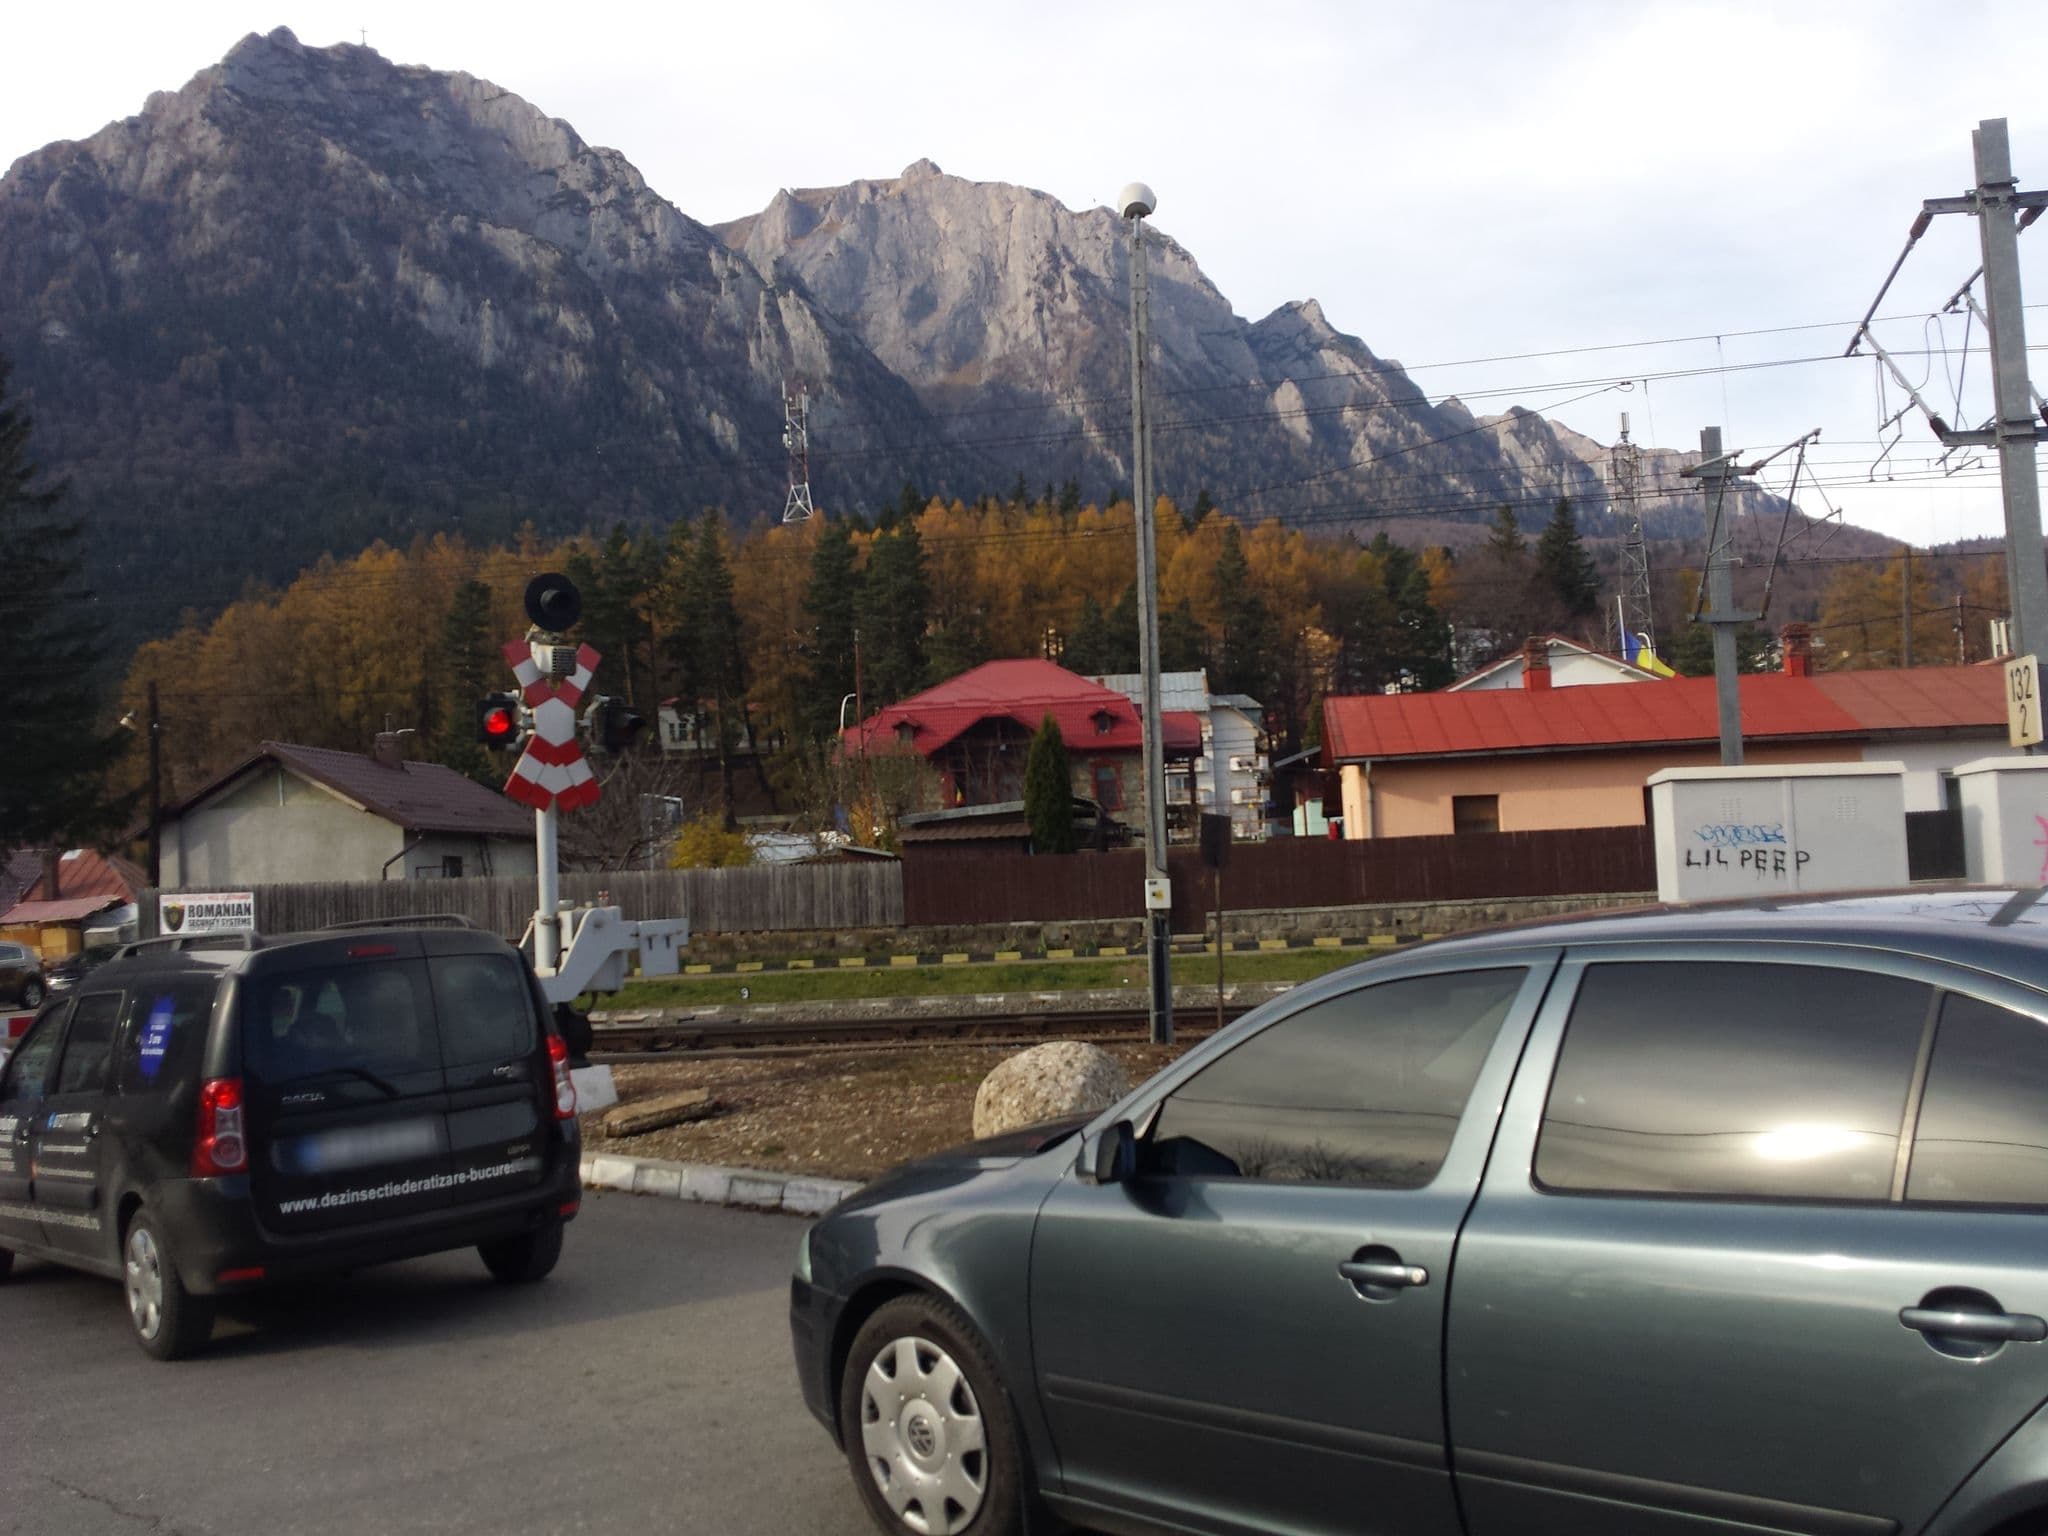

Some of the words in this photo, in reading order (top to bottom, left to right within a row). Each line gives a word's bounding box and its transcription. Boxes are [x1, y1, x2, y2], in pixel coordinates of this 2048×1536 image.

[2010, 665, 2032, 702] 132
[2020, 703, 2029, 738] 2
[1685, 849, 1729, 868] LIL
[1740, 849, 1810, 873] PEEP
[187, 903, 252, 918] ROMANIAN
[221, 918, 252, 927] SYSTEMS
